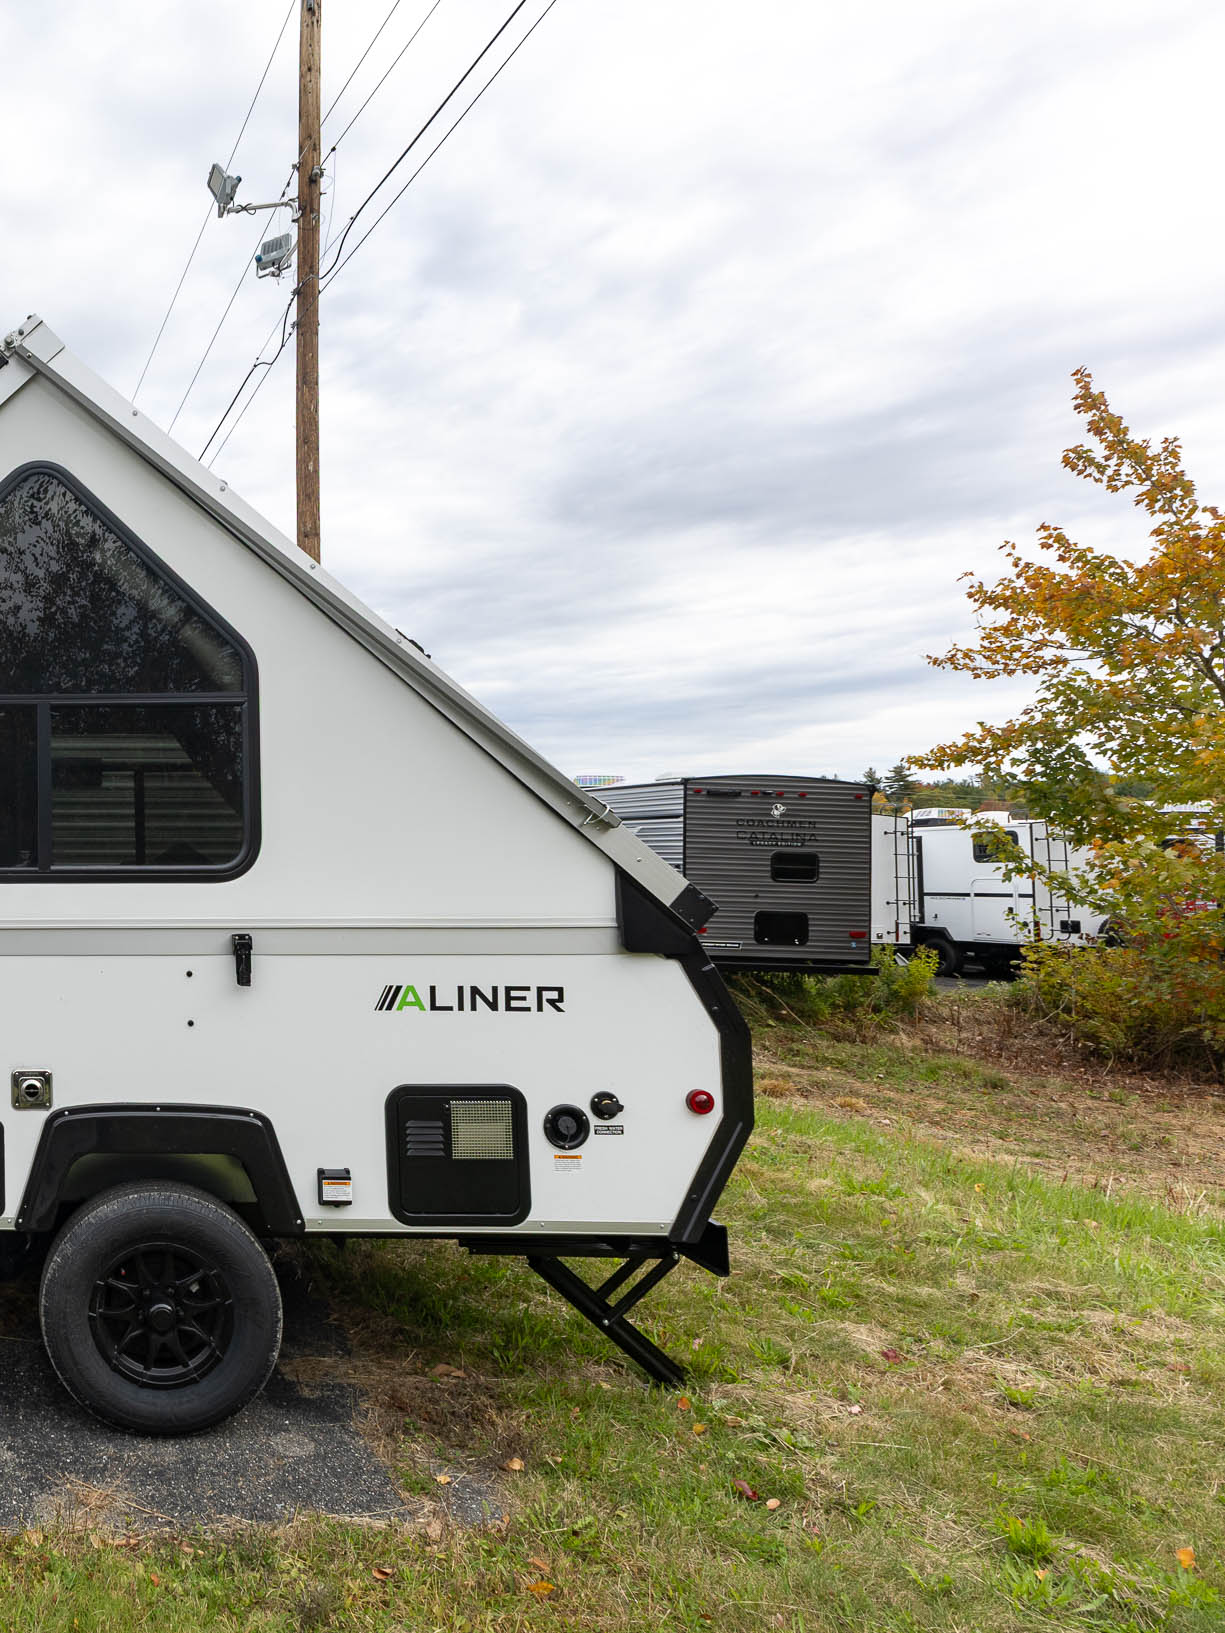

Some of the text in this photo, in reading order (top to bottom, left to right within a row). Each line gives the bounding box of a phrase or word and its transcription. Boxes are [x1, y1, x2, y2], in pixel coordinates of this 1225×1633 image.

[736, 818, 817, 828] COACHMEN
[736, 830, 818, 841] CATALINA
[396, 984, 566, 1013] ALINER
